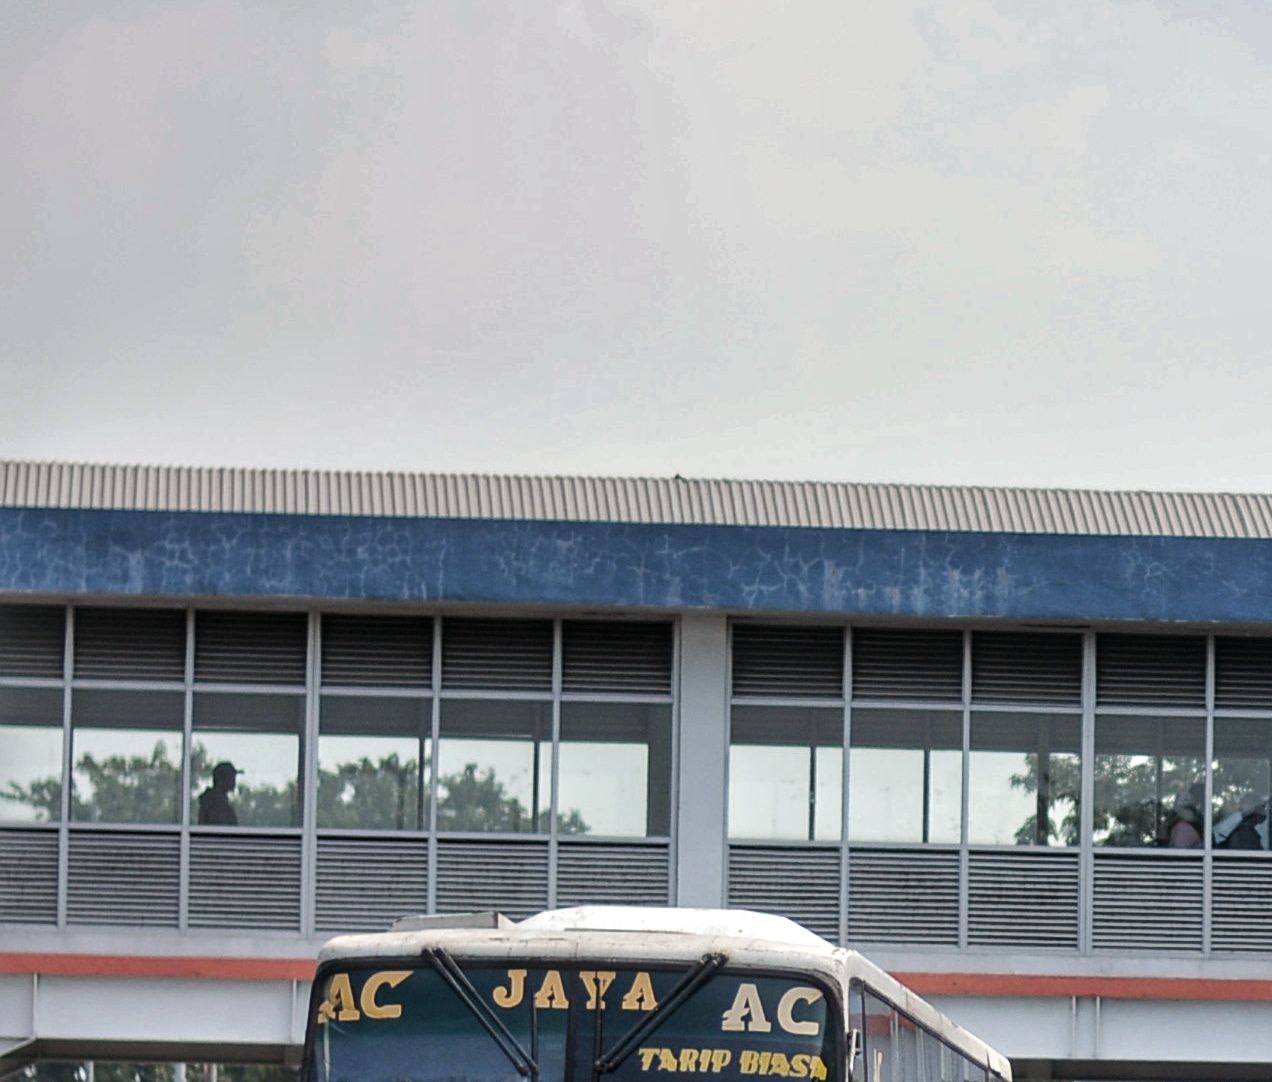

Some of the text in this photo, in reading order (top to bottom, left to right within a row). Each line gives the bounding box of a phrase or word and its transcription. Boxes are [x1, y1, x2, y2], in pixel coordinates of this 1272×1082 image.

[317, 969, 824, 1036] AC JAYA AC
[638, 1047, 828, 1082] TARIP BIASA
